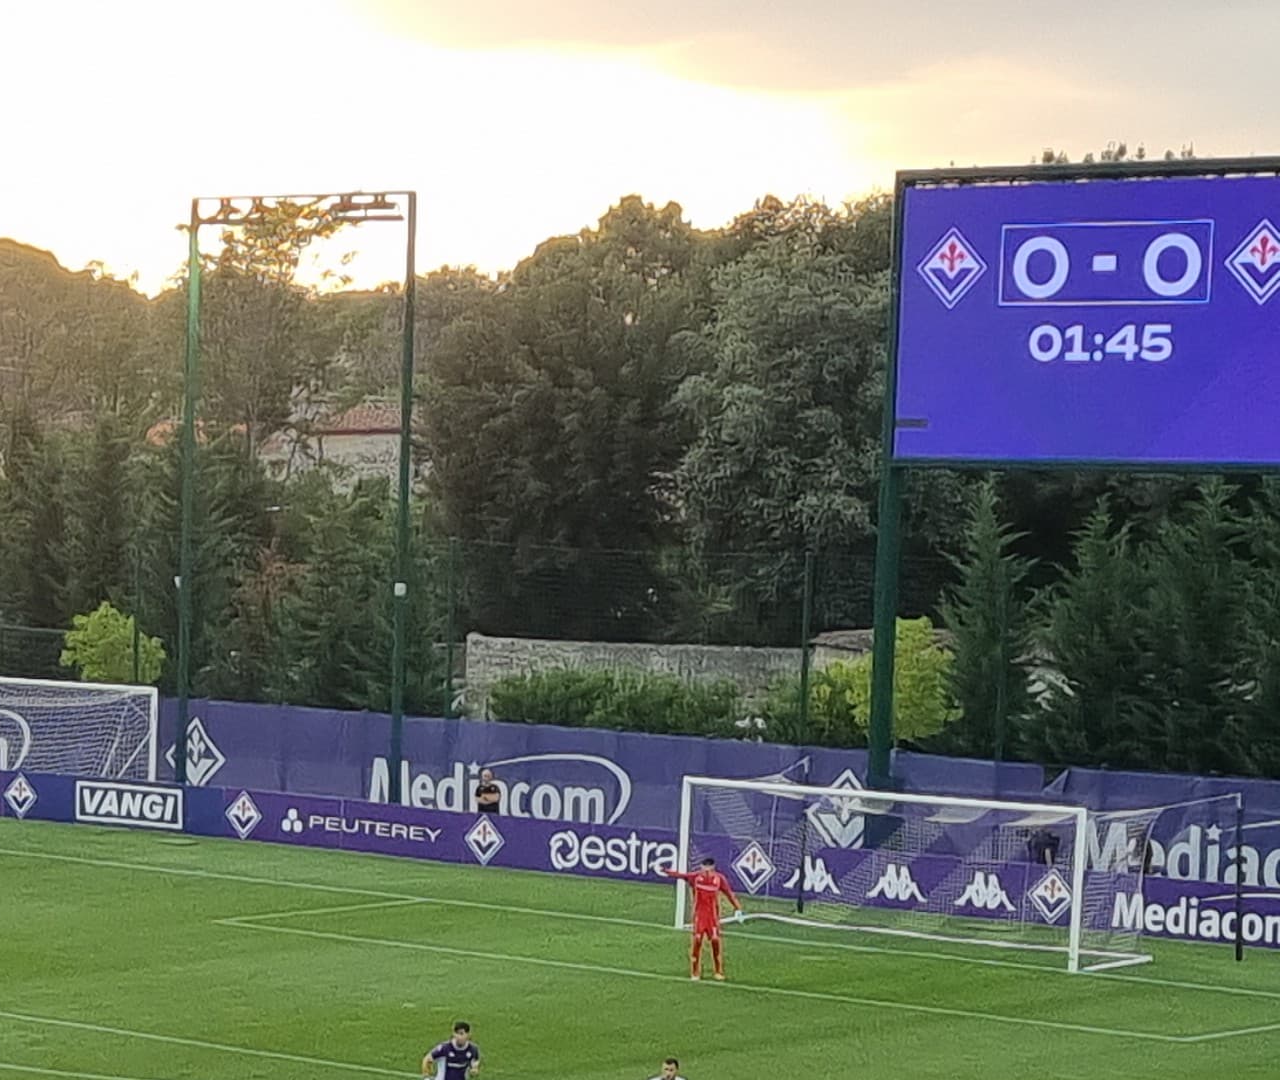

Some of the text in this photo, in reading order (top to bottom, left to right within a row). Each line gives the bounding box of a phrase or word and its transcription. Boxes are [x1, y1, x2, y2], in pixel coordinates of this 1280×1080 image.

[1012, 235, 1070, 300] 0
[1142, 232, 1203, 297] 0
[1028, 323, 1174, 362] 01:45
[82, 788, 175, 822] VANGI
[308, 815, 443, 843] PEUTEREY
[581, 831, 678, 877] estra
